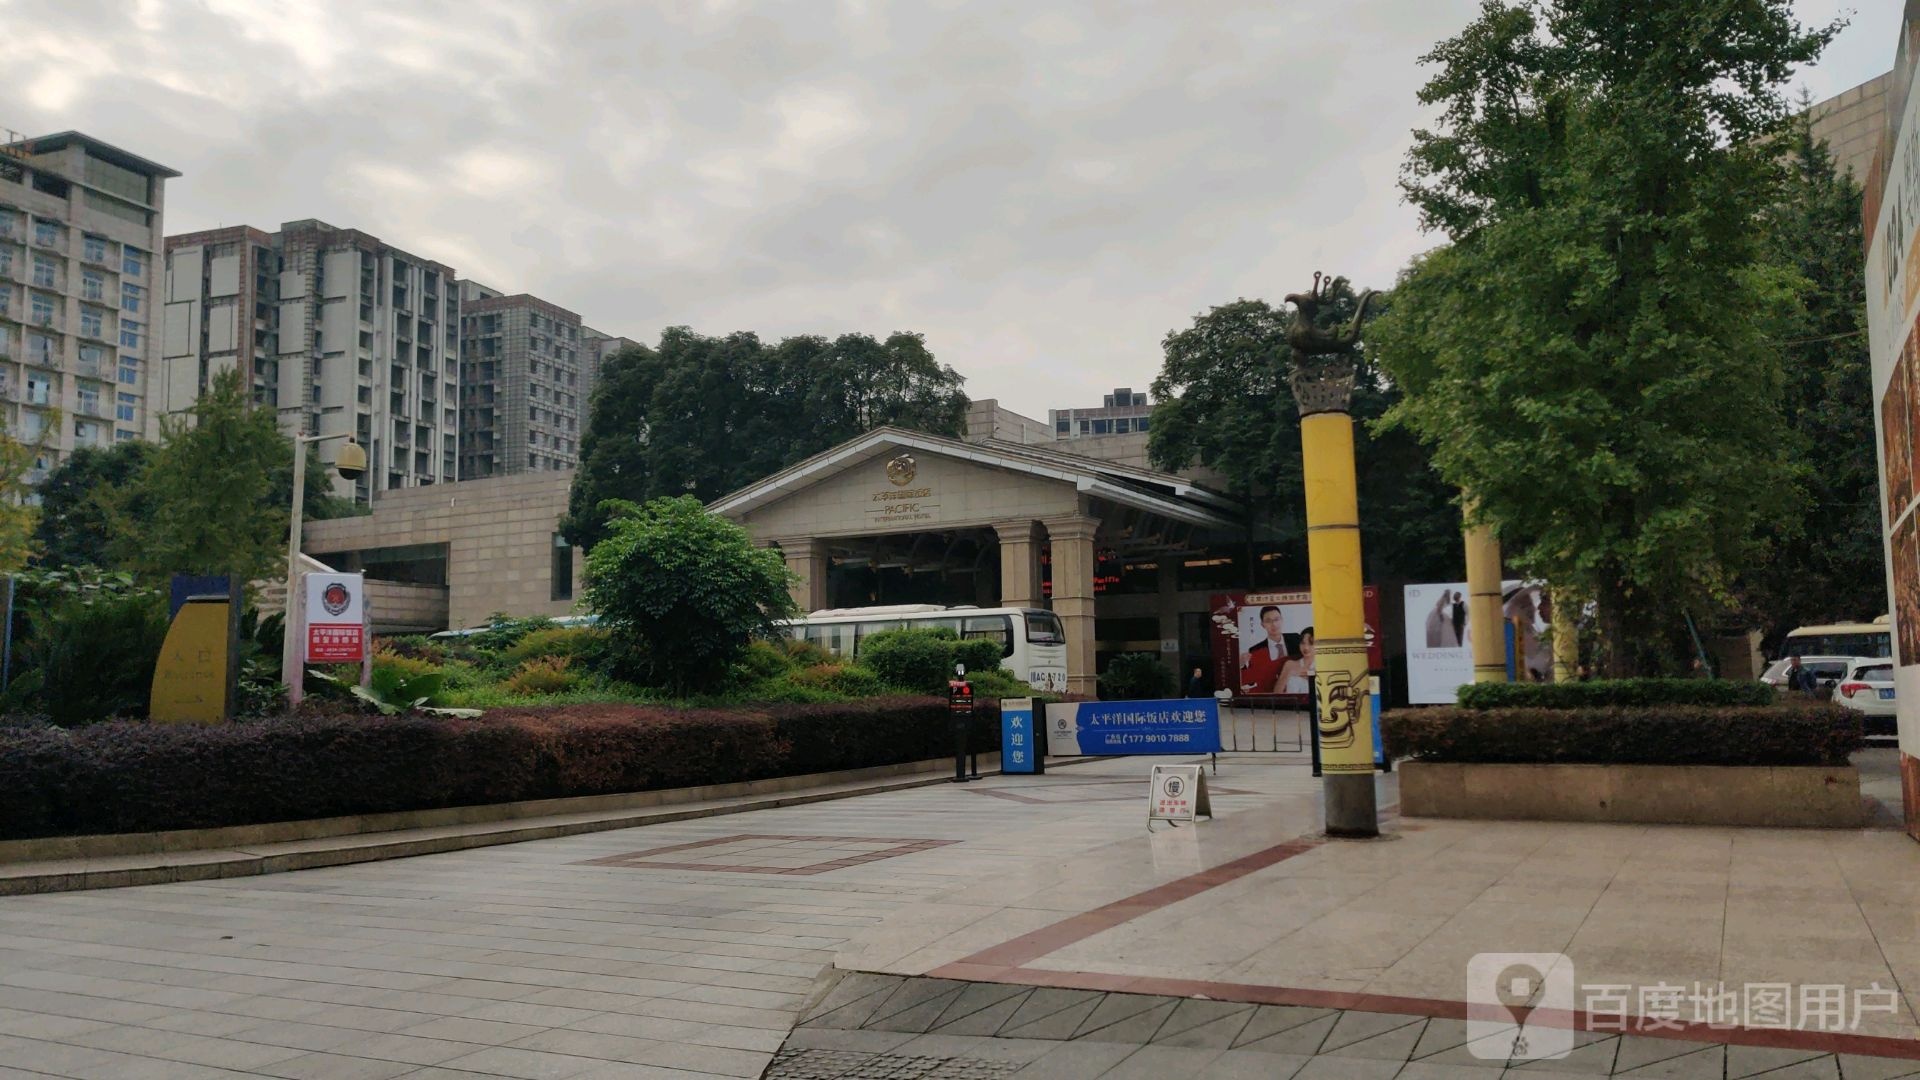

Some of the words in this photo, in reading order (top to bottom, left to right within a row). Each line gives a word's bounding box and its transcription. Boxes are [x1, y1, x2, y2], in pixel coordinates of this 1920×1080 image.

[885, 503, 920, 514] PACIFIC
[1091, 710, 1206, 726] 太平洋国际饭店欢迎您
[1011, 716, 1024, 763] 欢迎您
[1128, 735, 1143, 744] 177
[1145, 735, 1167, 743] 9010
